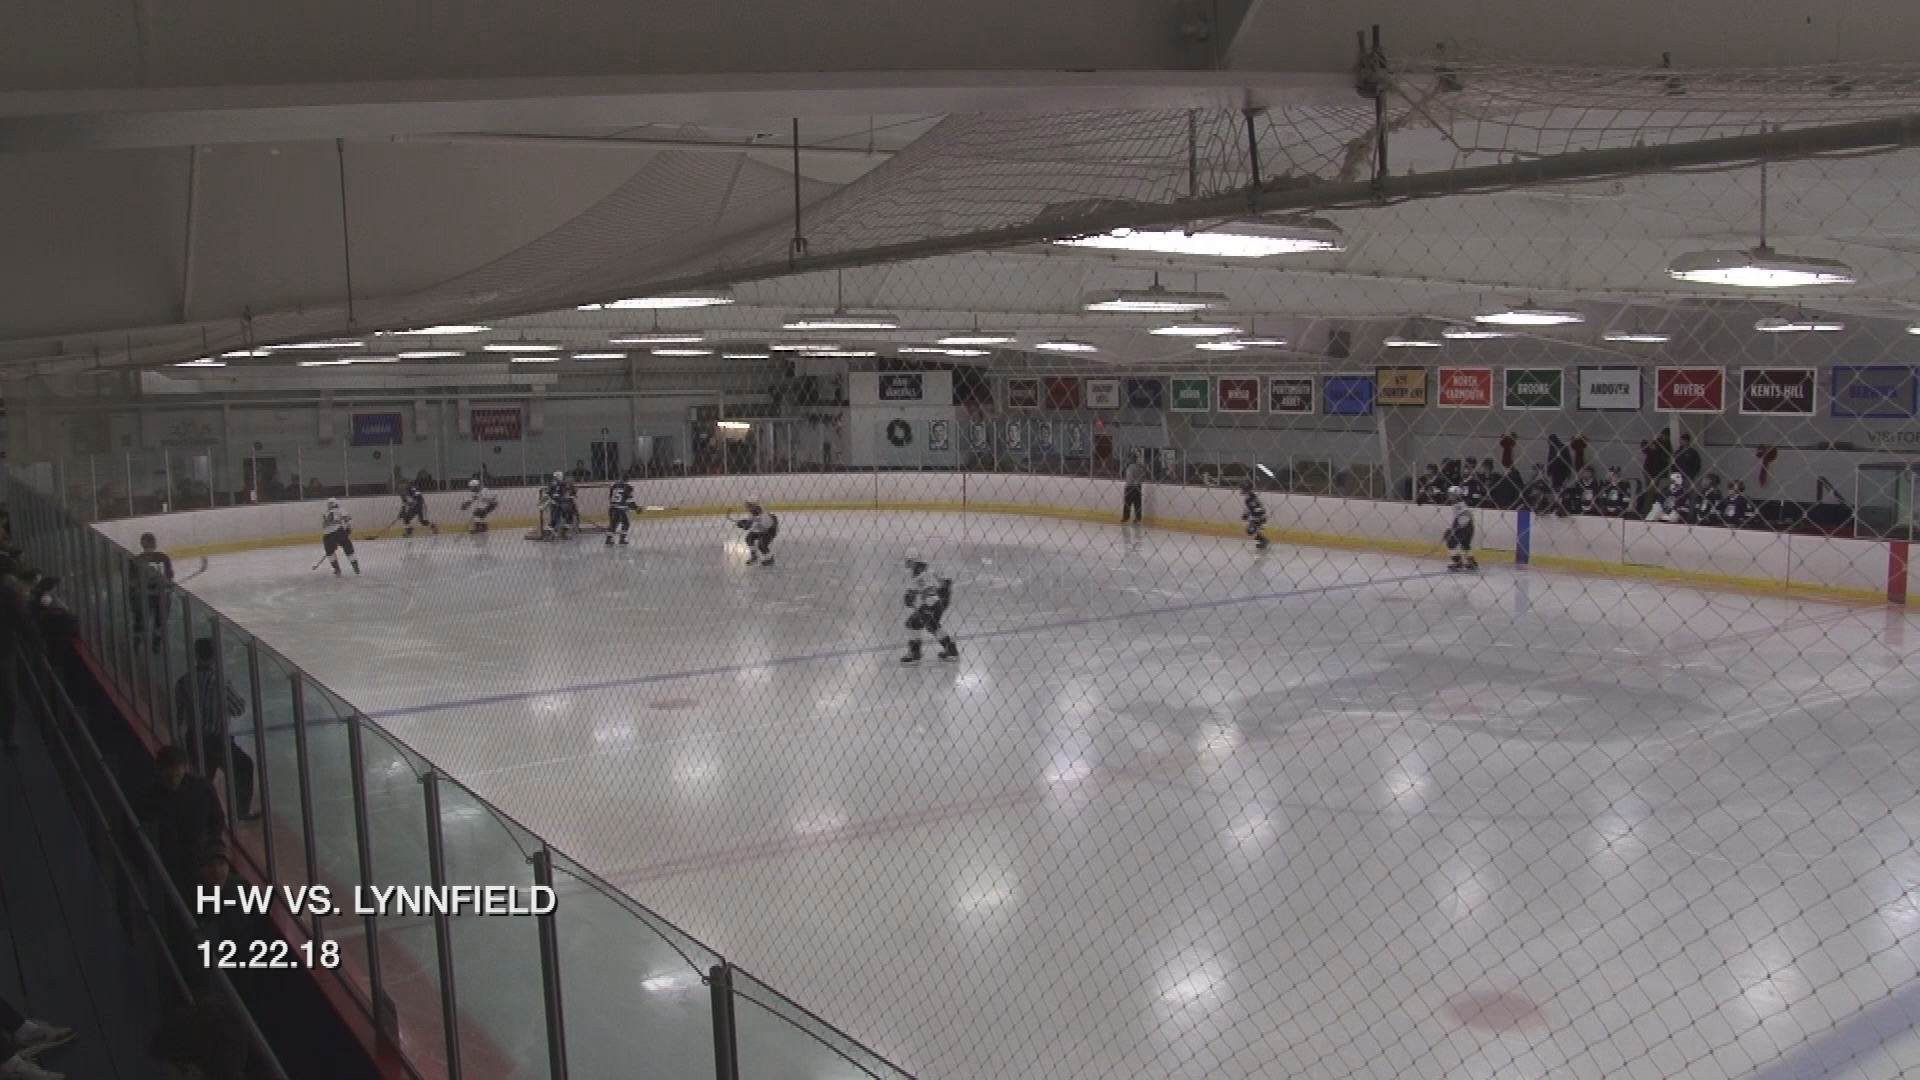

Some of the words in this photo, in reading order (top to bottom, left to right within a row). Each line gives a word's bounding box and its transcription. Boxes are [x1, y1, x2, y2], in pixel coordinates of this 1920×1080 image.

[1453, 376, 1477, 387] NORTH
[1446, 388, 1485, 400] YARMOUTH
[1517, 383, 1549, 395] BROOKS
[1590, 383, 1630, 395] ANDOVER
[1673, 384, 1706, 397] RIVERS
[1750, 385, 1781, 398] KENTS
[1784, 385, 1805, 399] HILL
